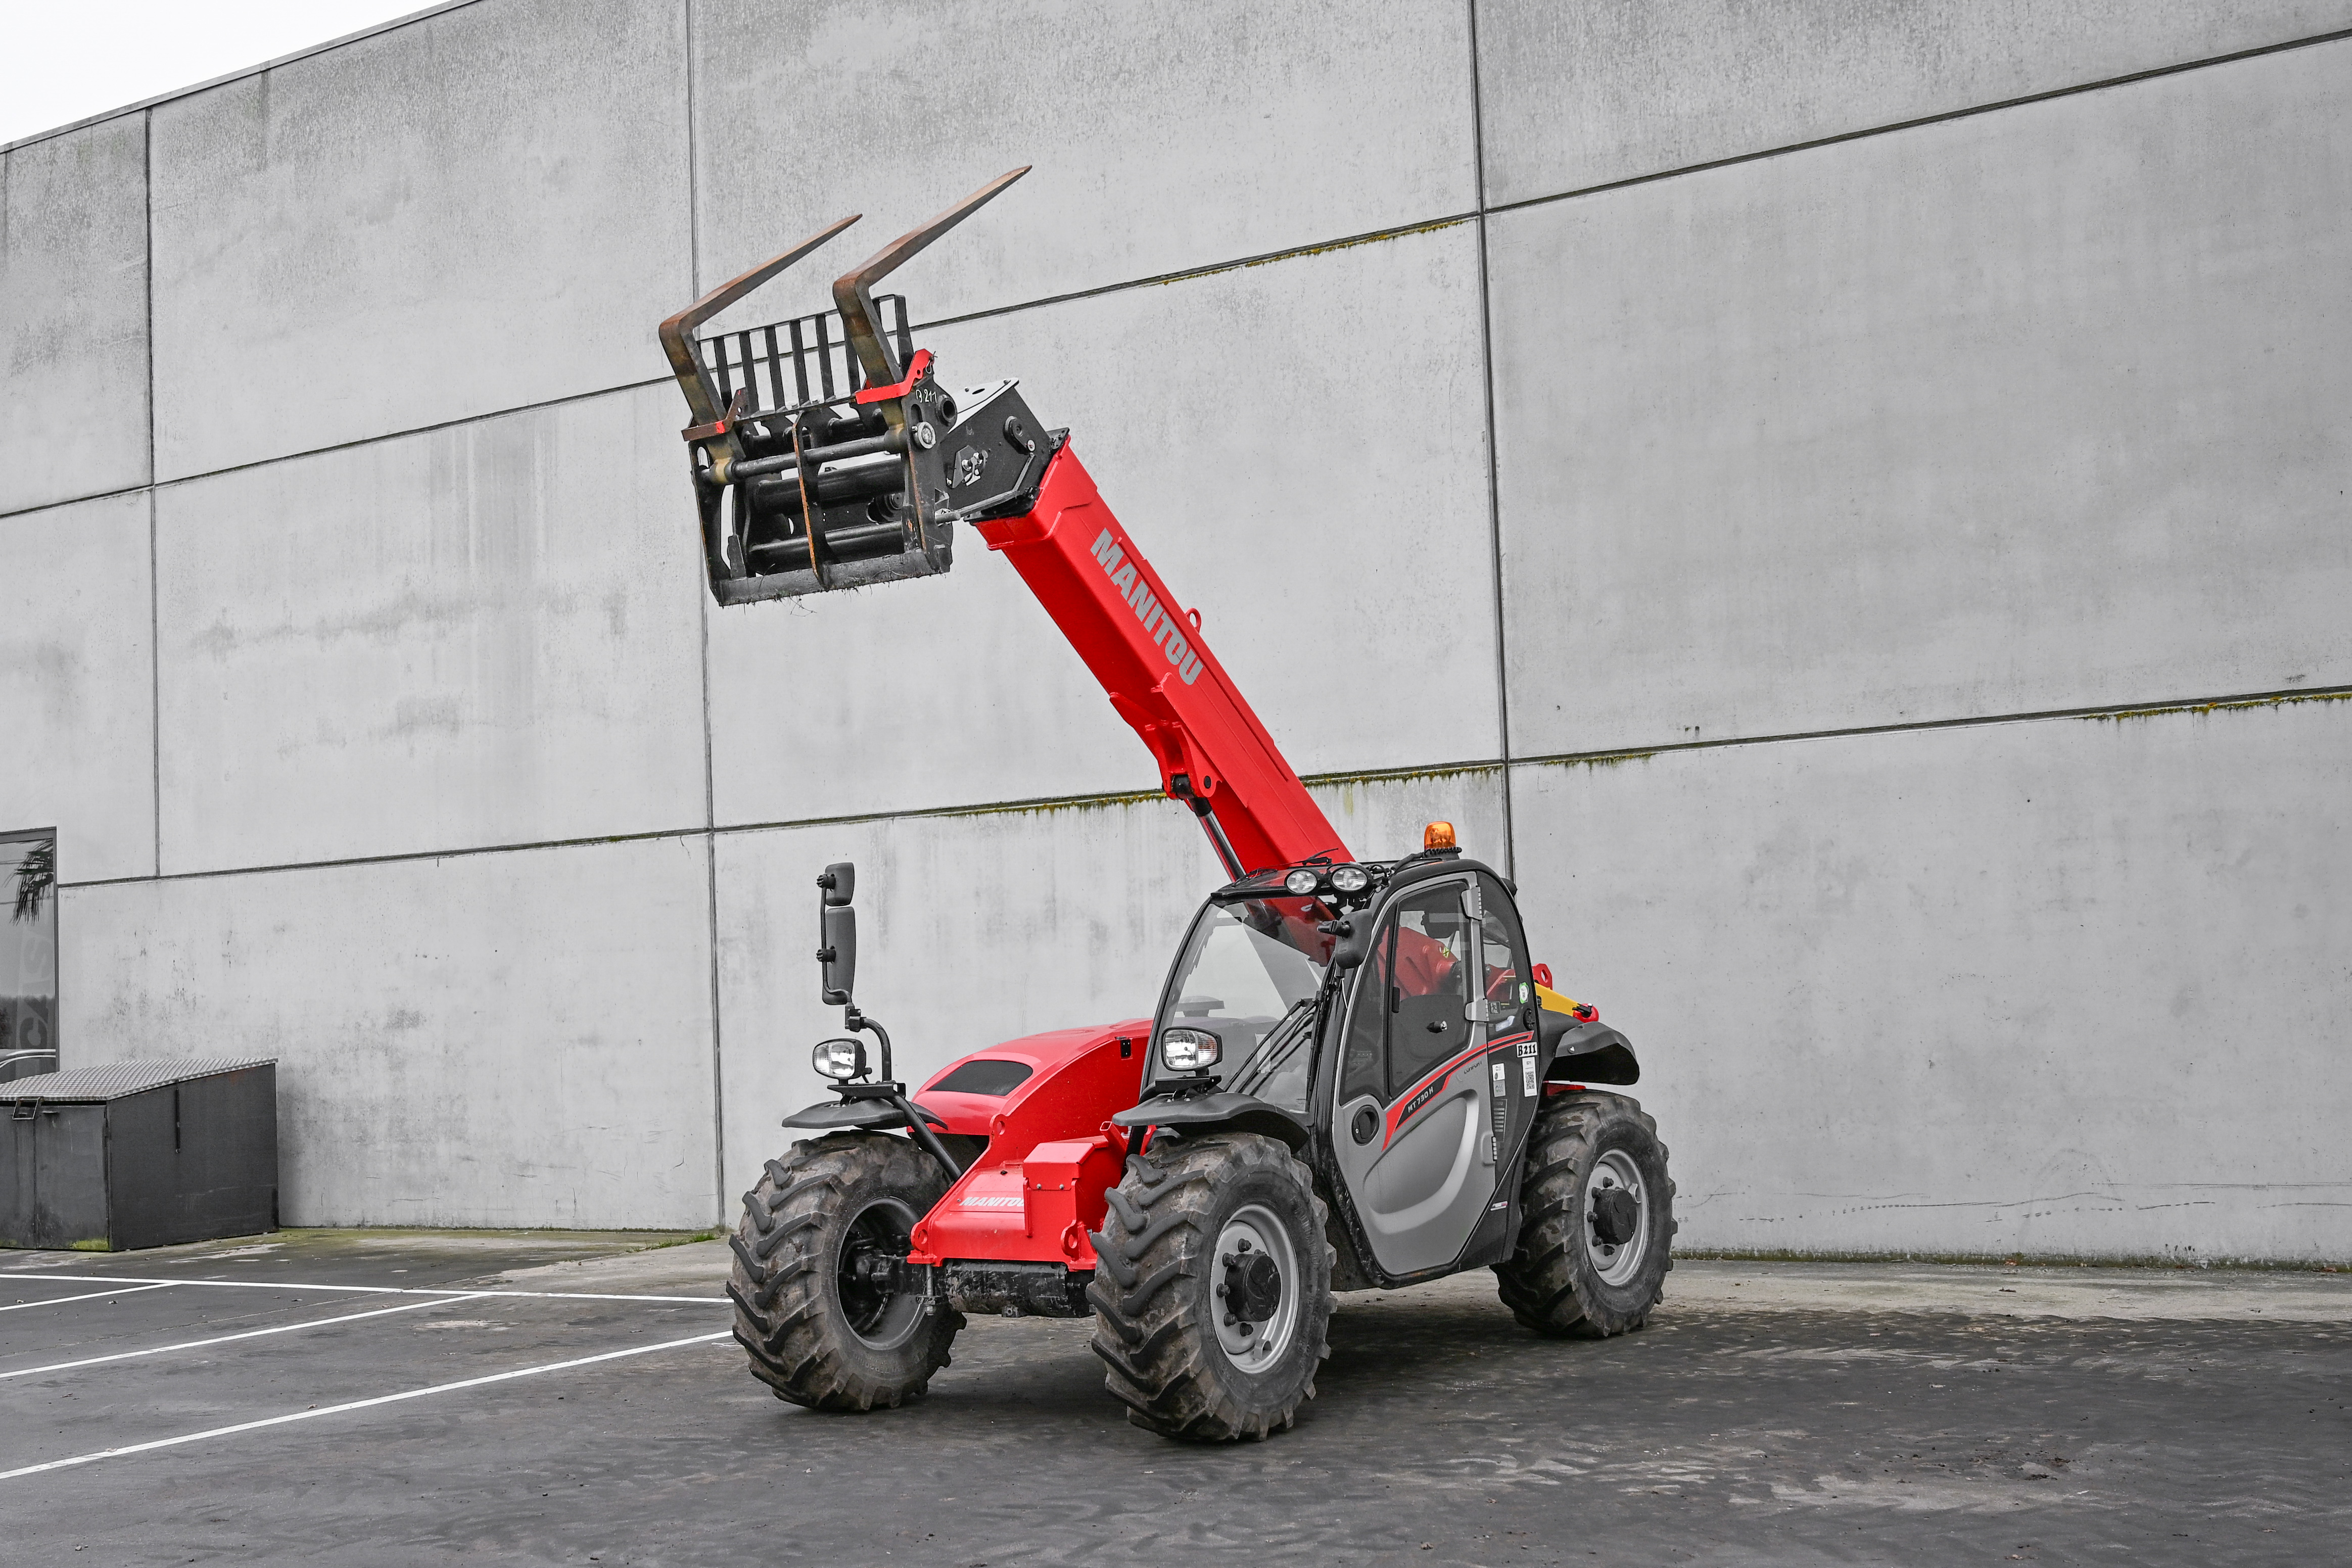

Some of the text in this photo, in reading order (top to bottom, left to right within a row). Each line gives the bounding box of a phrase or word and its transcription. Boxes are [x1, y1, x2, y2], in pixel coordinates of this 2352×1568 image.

[1090, 528, 1203, 685] MANITOU
[1518, 1043, 1536, 1056] B211
[1408, 1086, 1433, 1113] MT 730 H
